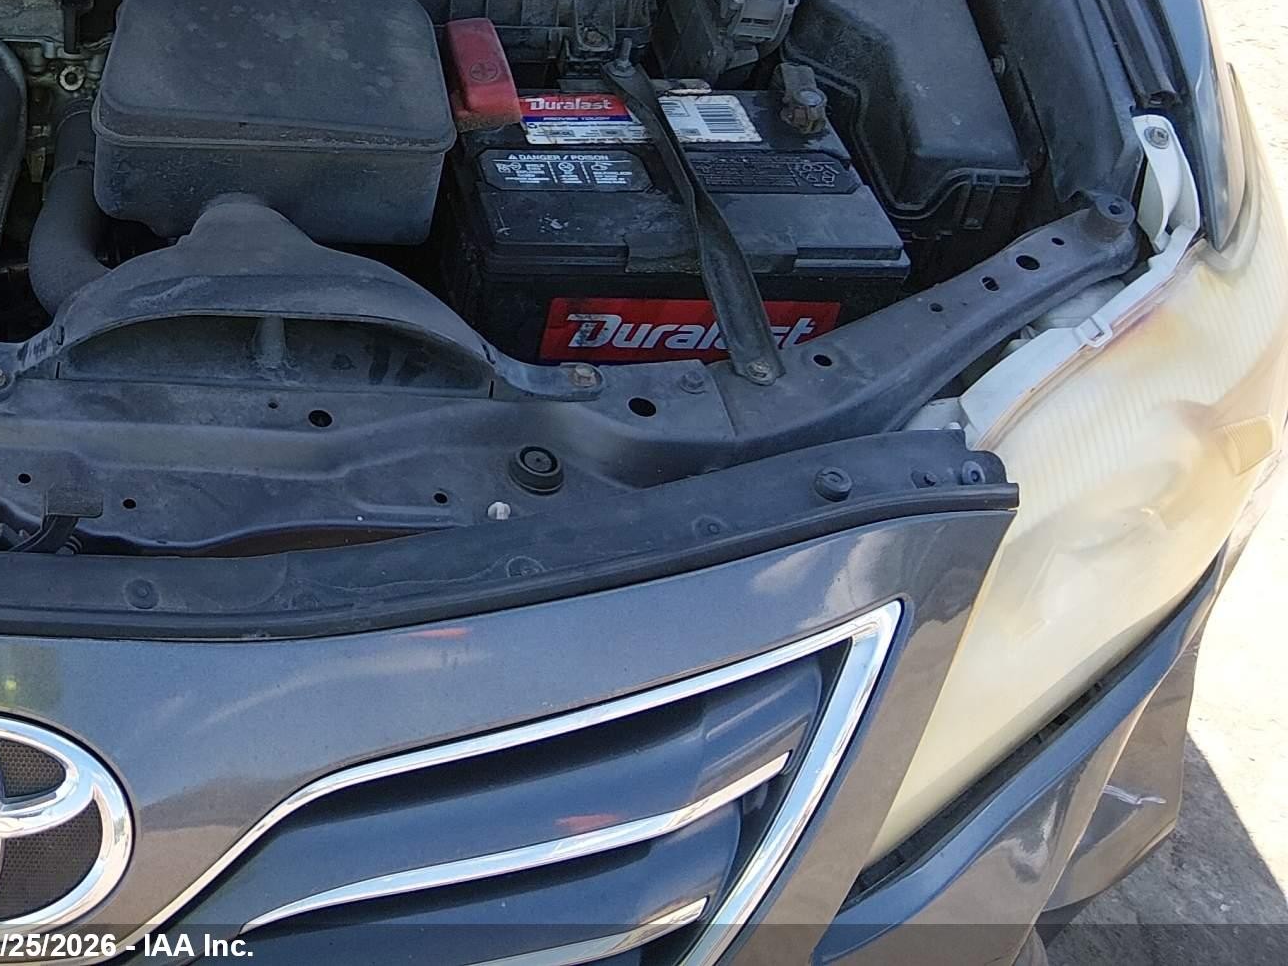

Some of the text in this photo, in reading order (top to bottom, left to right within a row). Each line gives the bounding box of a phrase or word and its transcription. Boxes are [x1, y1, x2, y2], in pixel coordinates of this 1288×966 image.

[524, 96, 613, 111] Duralast
[518, 153, 561, 161] DANGER
[571, 153, 609, 161] POISON
